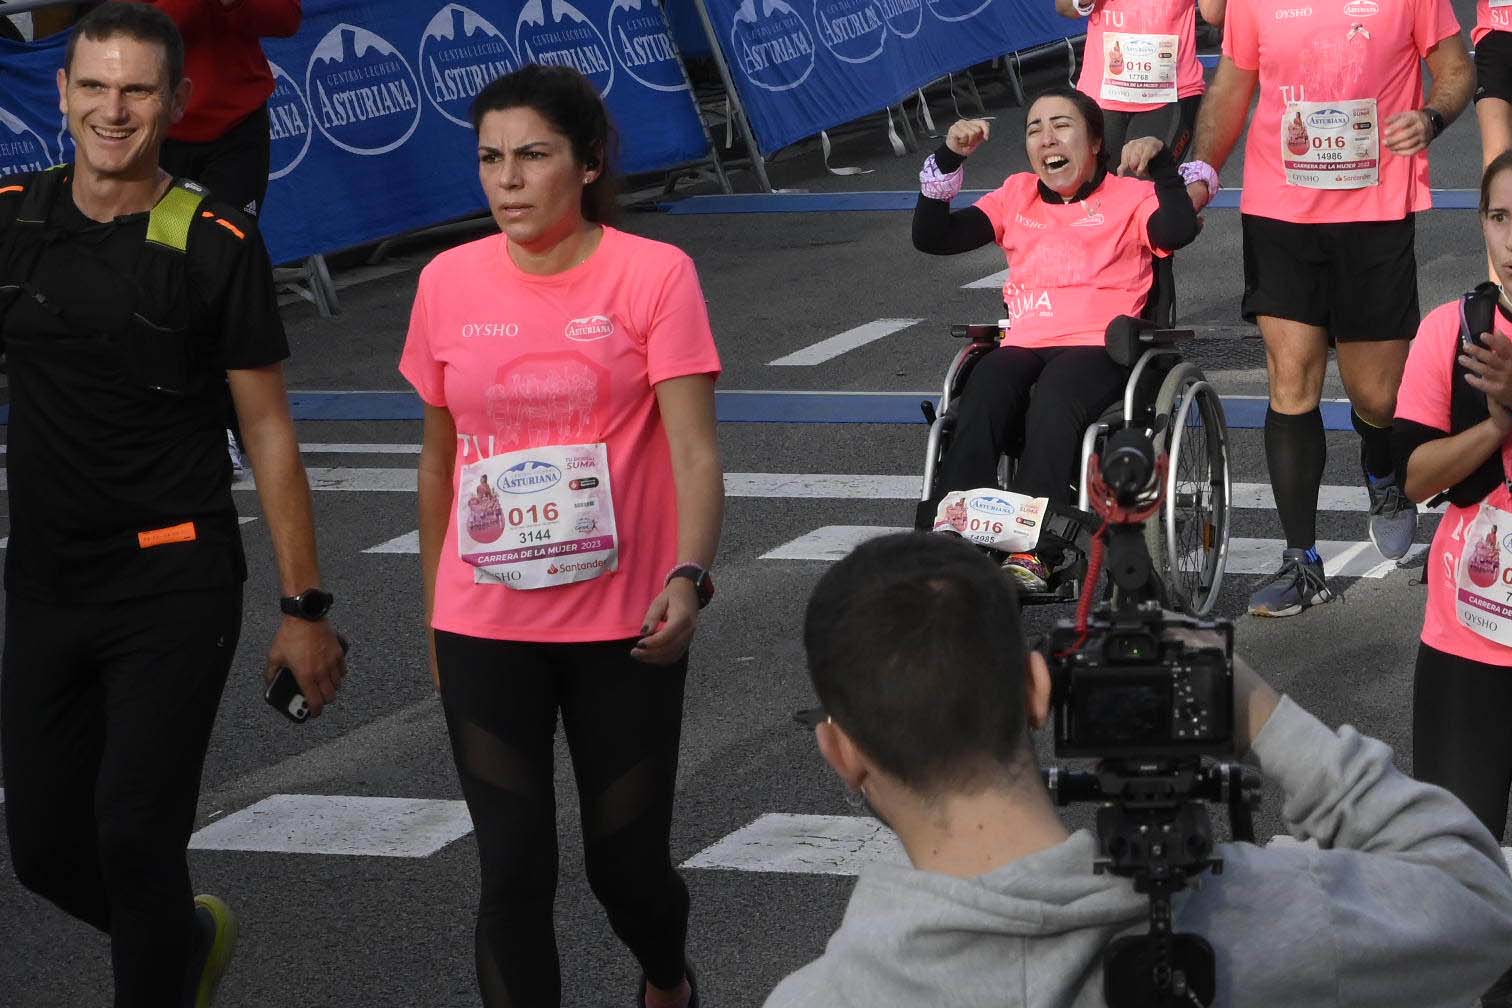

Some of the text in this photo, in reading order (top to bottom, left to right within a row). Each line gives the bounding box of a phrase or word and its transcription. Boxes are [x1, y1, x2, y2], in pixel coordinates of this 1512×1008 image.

[1104, 10, 1124, 28] TU
[1275, 8, 1312, 20] OYSHO
[1126, 62, 1152, 72] 016
[319, 79, 416, 129] ASTURIANA
[1313, 136, 1345, 148] 016
[462, 323, 519, 338] OYSHO
[567, 323, 611, 337] ASTURIANA
[567, 461, 595, 469] SUMA
[502, 473, 557, 489] ASTURIANA
[509, 502, 559, 527] 016
[970, 519, 1003, 533] 016
[519, 529, 551, 544] 3144
[478, 541, 601, 564] CARRERA DE LA MUJER 2023
[1469, 596, 1500, 616] CARRERA
[1502, 606, 1512, 617] DE
[1464, 611, 1498, 632] OYSHO
